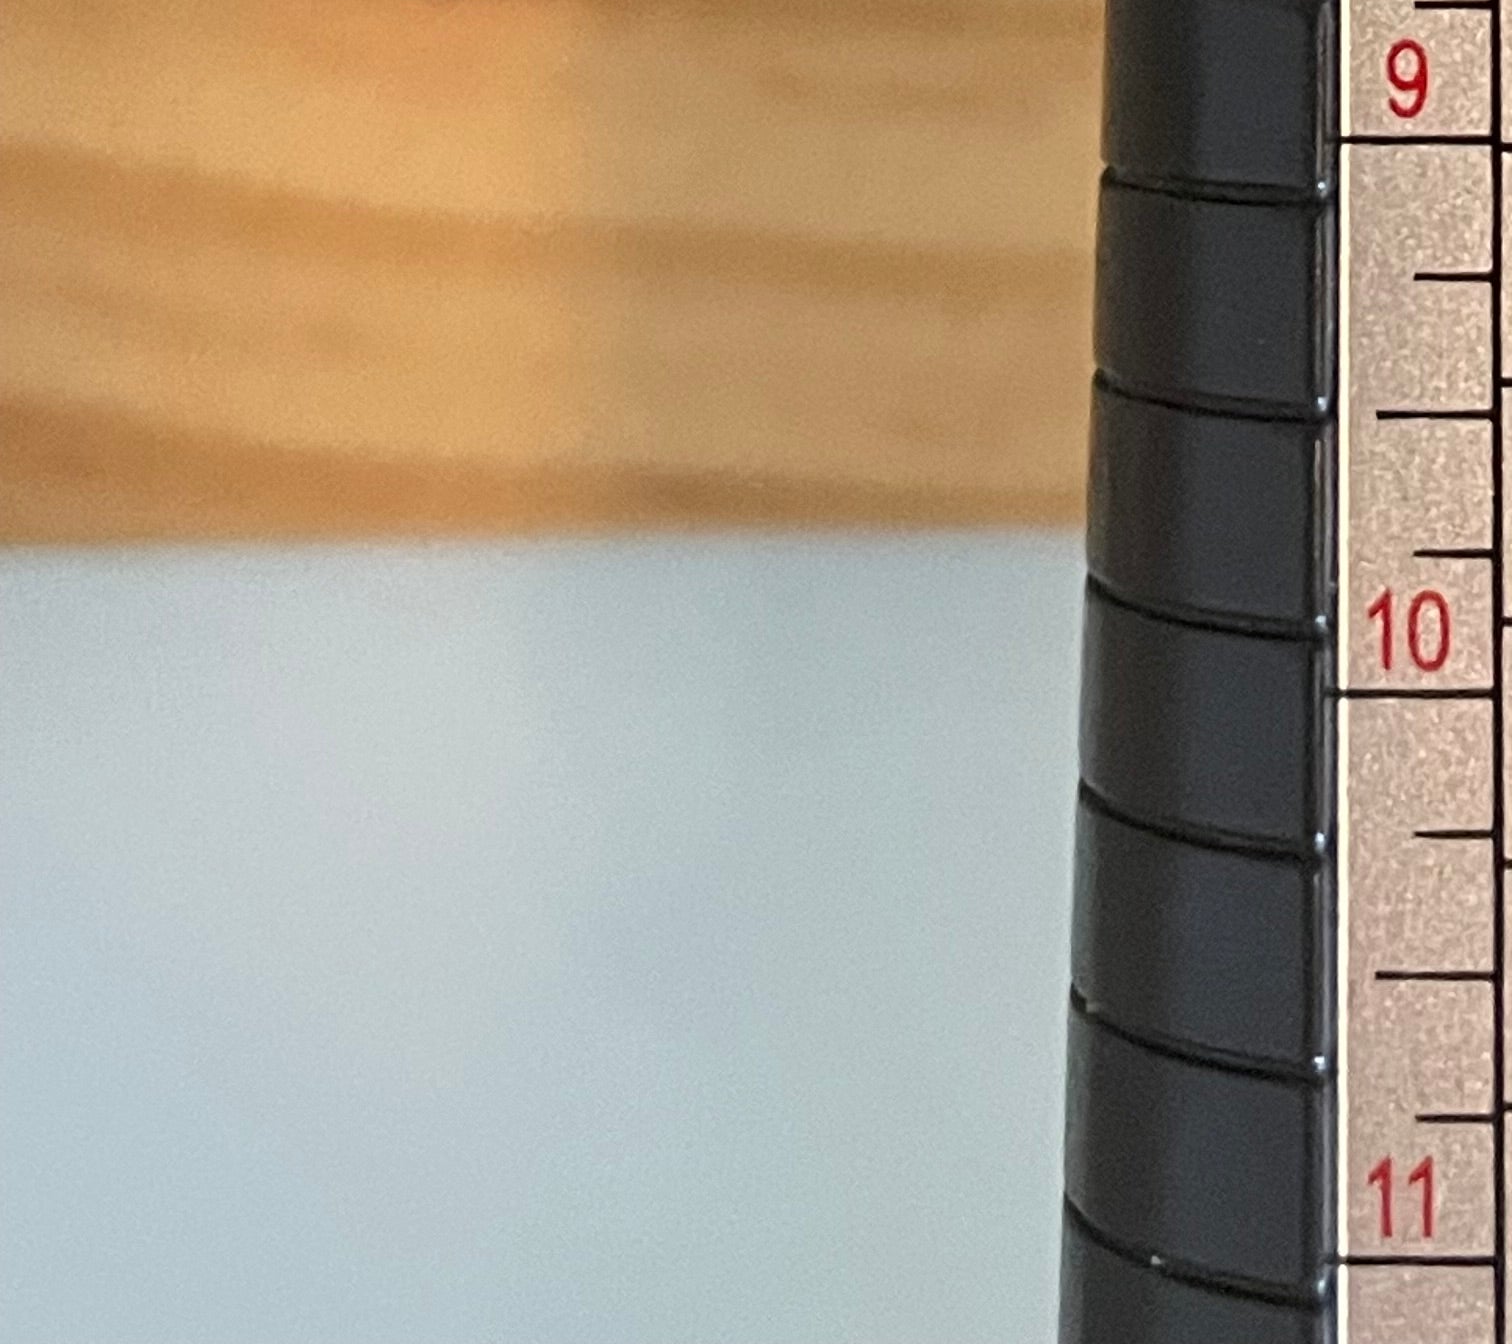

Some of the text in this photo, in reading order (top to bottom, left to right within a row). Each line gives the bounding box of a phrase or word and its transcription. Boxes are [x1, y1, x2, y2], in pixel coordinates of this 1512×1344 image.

[1386, 38, 1430, 119] 9
[1366, 589, 1452, 673] 10
[1366, 1155, 1435, 1239] 11
